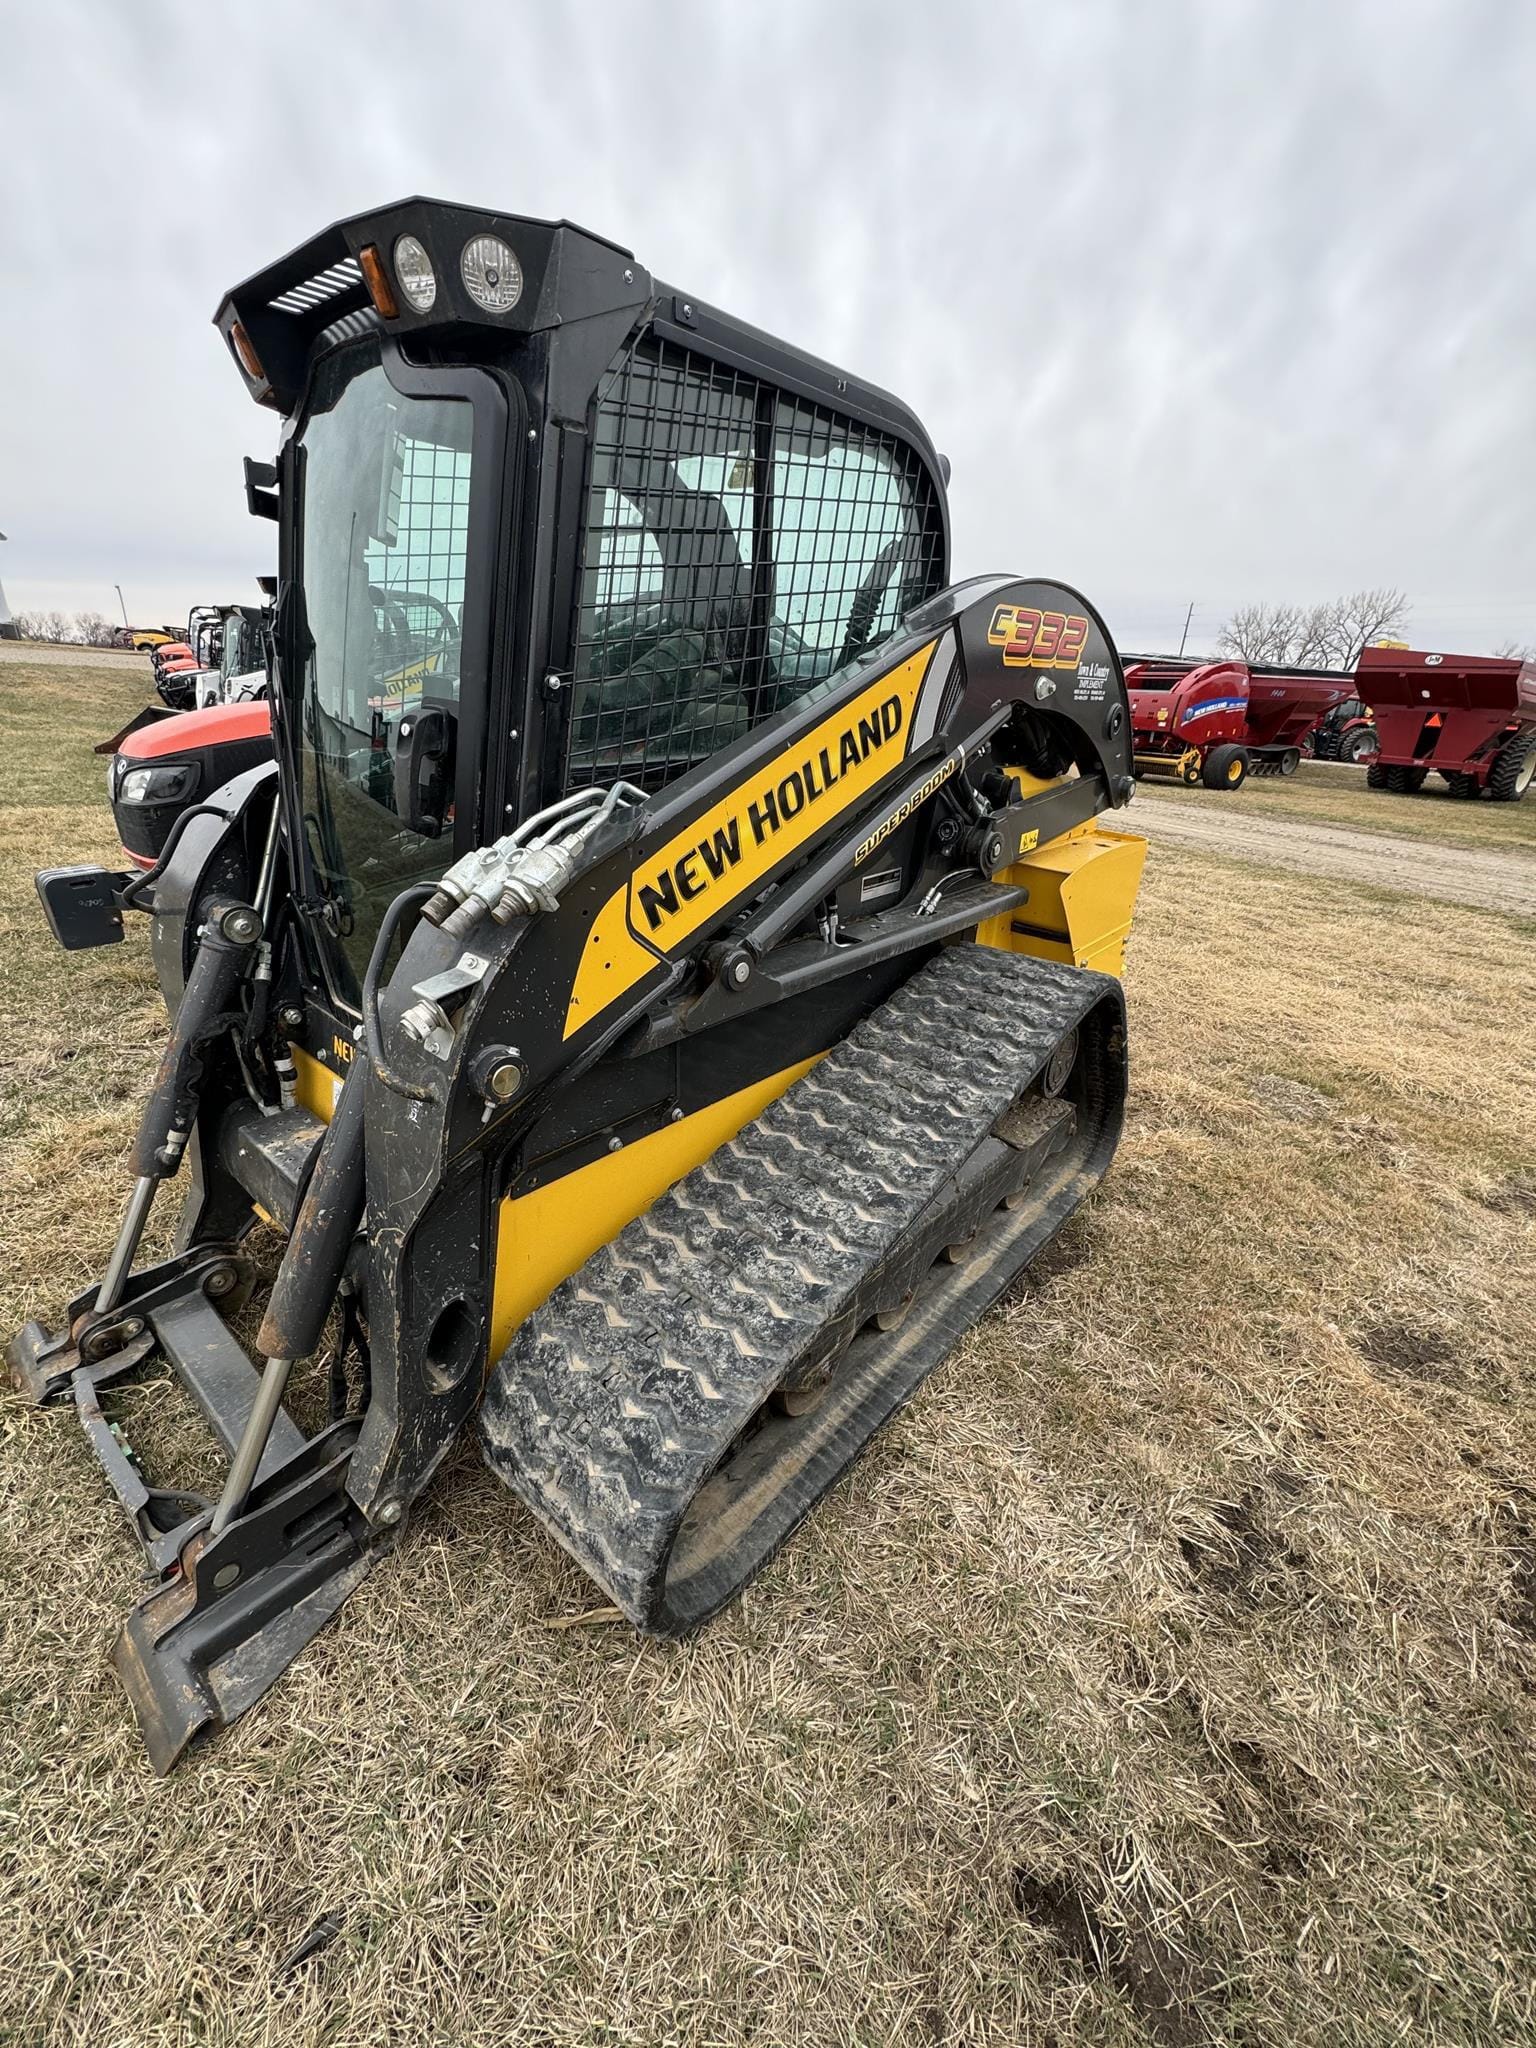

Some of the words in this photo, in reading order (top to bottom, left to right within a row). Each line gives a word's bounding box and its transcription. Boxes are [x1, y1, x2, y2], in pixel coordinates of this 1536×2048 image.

[1193, 707, 1206, 717] NEW
[1206, 701, 1228, 713] HOLLAND
[637, 815, 744, 932] NEW
[746, 694, 904, 846] HOLLAND
